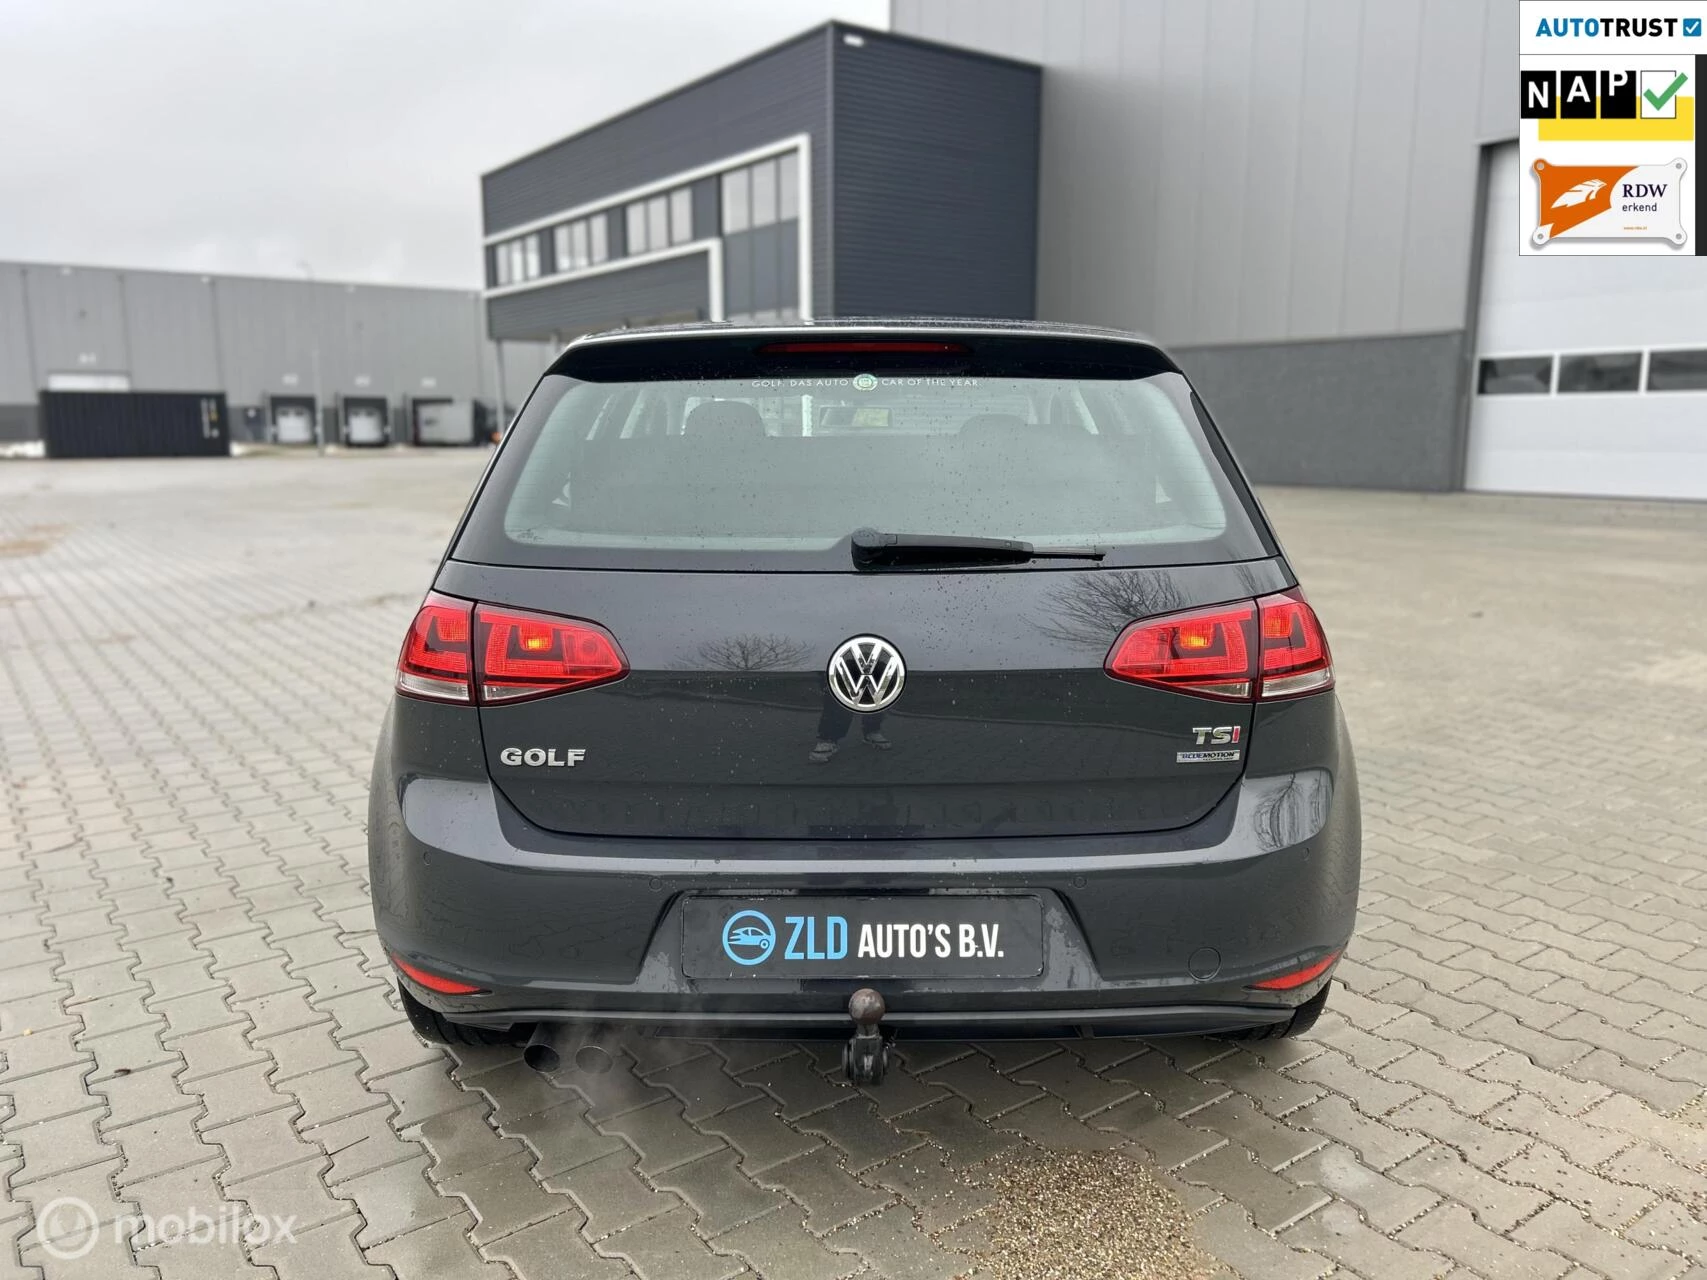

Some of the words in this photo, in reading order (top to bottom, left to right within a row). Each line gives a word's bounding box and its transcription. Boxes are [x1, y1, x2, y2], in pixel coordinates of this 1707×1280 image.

[790, 379, 813, 387] DAS
[816, 379, 849, 387] AUTO
[881, 378, 904, 387] CAR
[907, 378, 922, 387] OF
[926, 378, 946, 387] THE
[500, 747, 586, 767] GOLF
[784, 916, 848, 960] ZLD
[857, 923, 951, 958] AUTO'S
[959, 923, 1004, 958] B.V.
